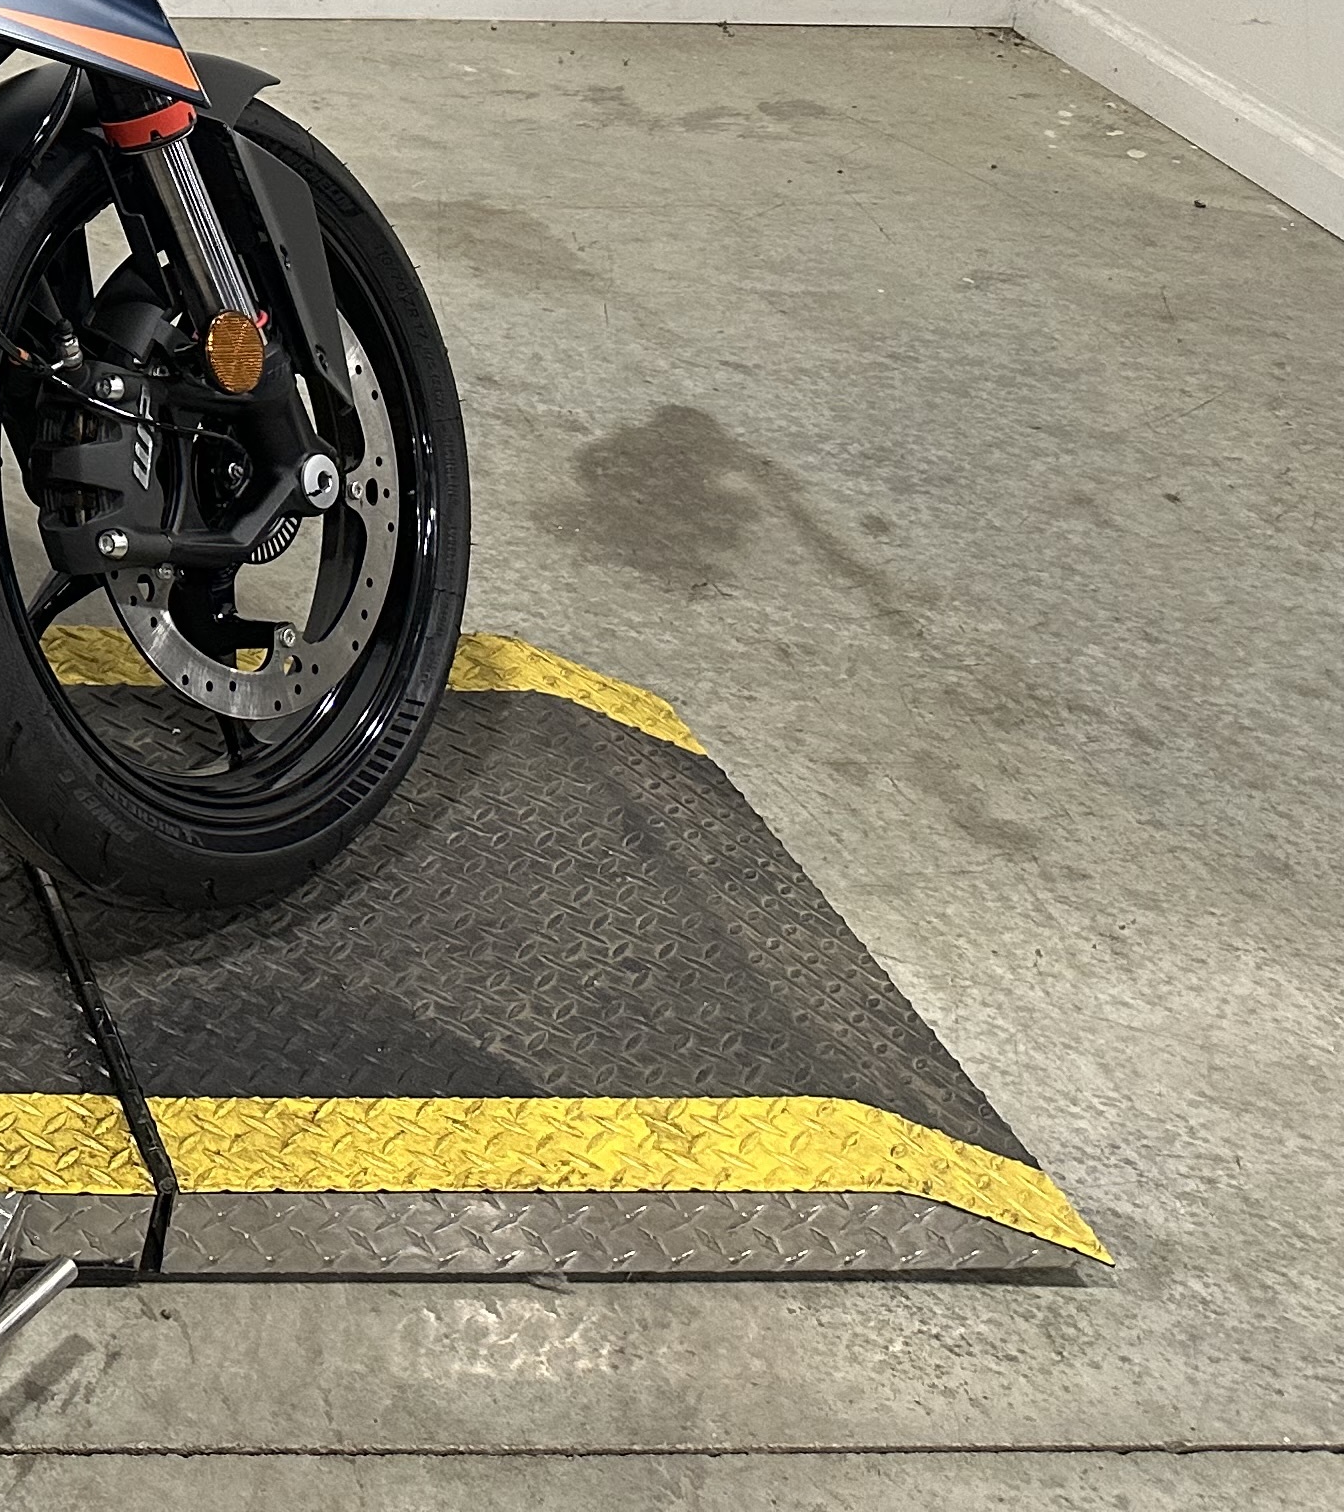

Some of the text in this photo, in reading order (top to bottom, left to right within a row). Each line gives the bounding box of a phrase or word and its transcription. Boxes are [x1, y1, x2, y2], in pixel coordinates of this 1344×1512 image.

[132, 383, 154, 490] WP
[72, 788, 141, 844] POWER
[101, 777, 182, 839] MICHELIN
